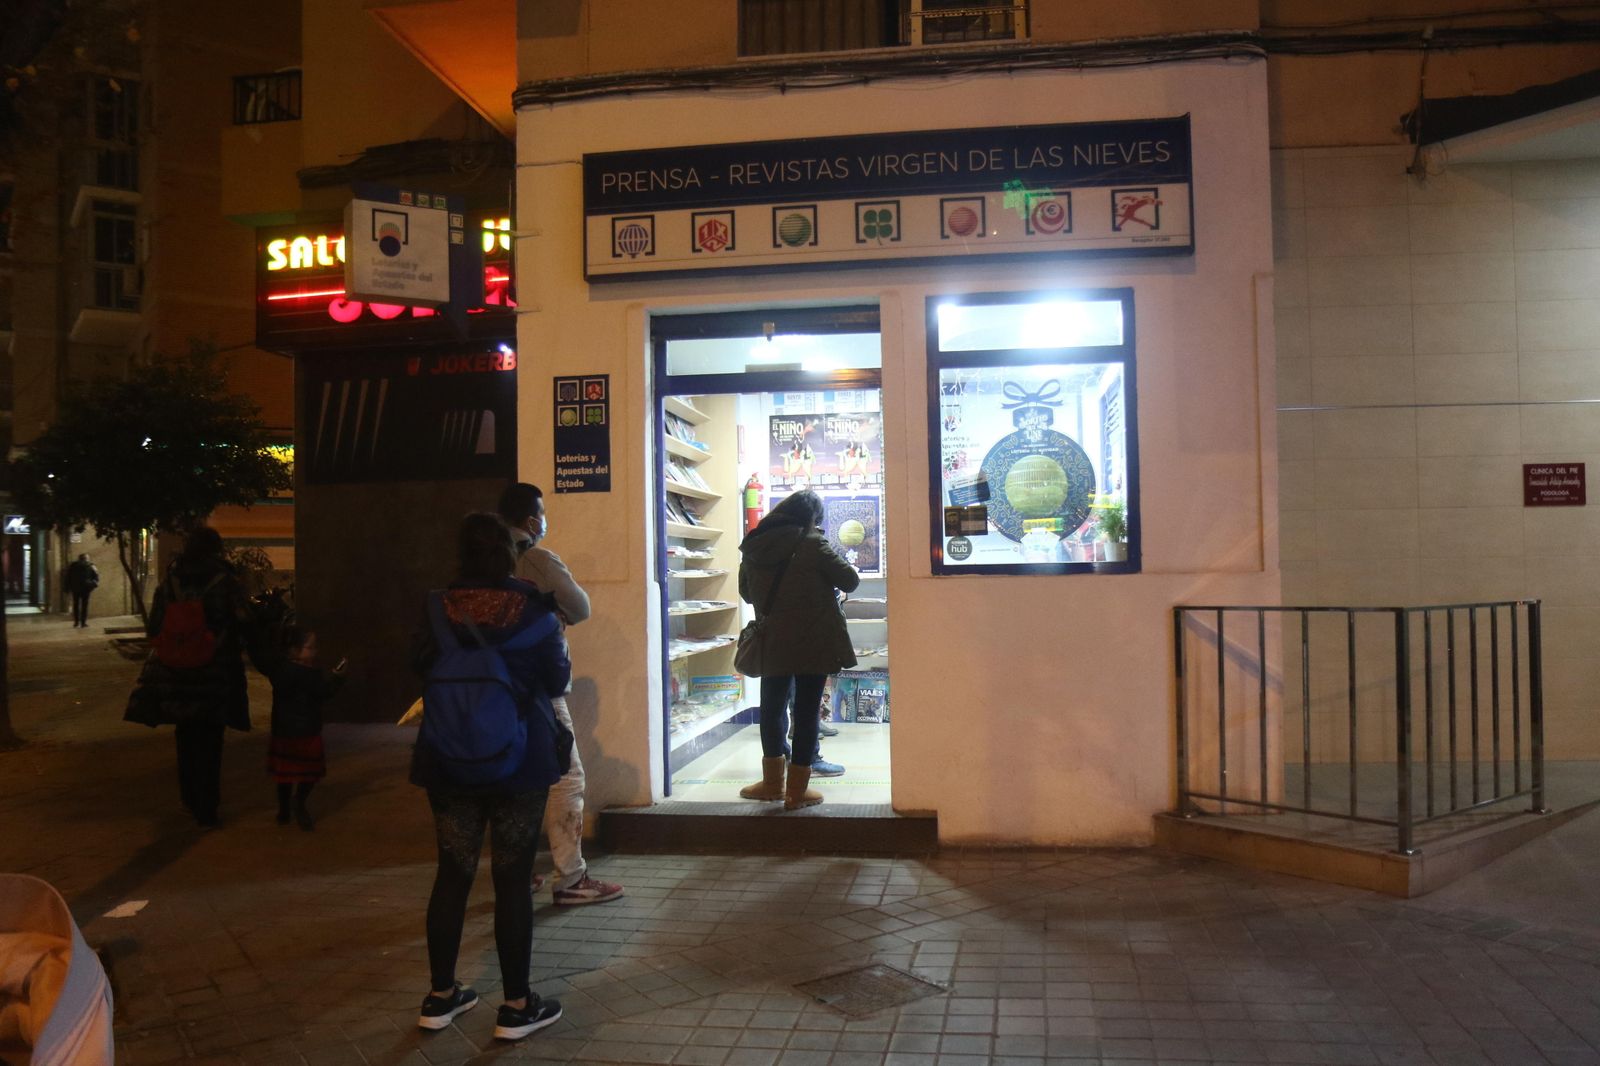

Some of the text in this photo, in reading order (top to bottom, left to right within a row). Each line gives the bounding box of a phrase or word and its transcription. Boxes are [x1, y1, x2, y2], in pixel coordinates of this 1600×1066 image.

[602, 168, 701, 194] PRENSA
[729, 157, 849, 185] REVISTAS
[858, 152, 958, 177] VIRGEN
[969, 150, 1004, 171] DE
[1014, 146, 1064, 169] LAS
[1073, 141, 1171, 166] NIEVES
[591, 455, 597, 464] y
[556, 465, 609, 477] Apuestas del
[556, 479, 585, 488] Estado
[951, 545, 968, 553] hub
